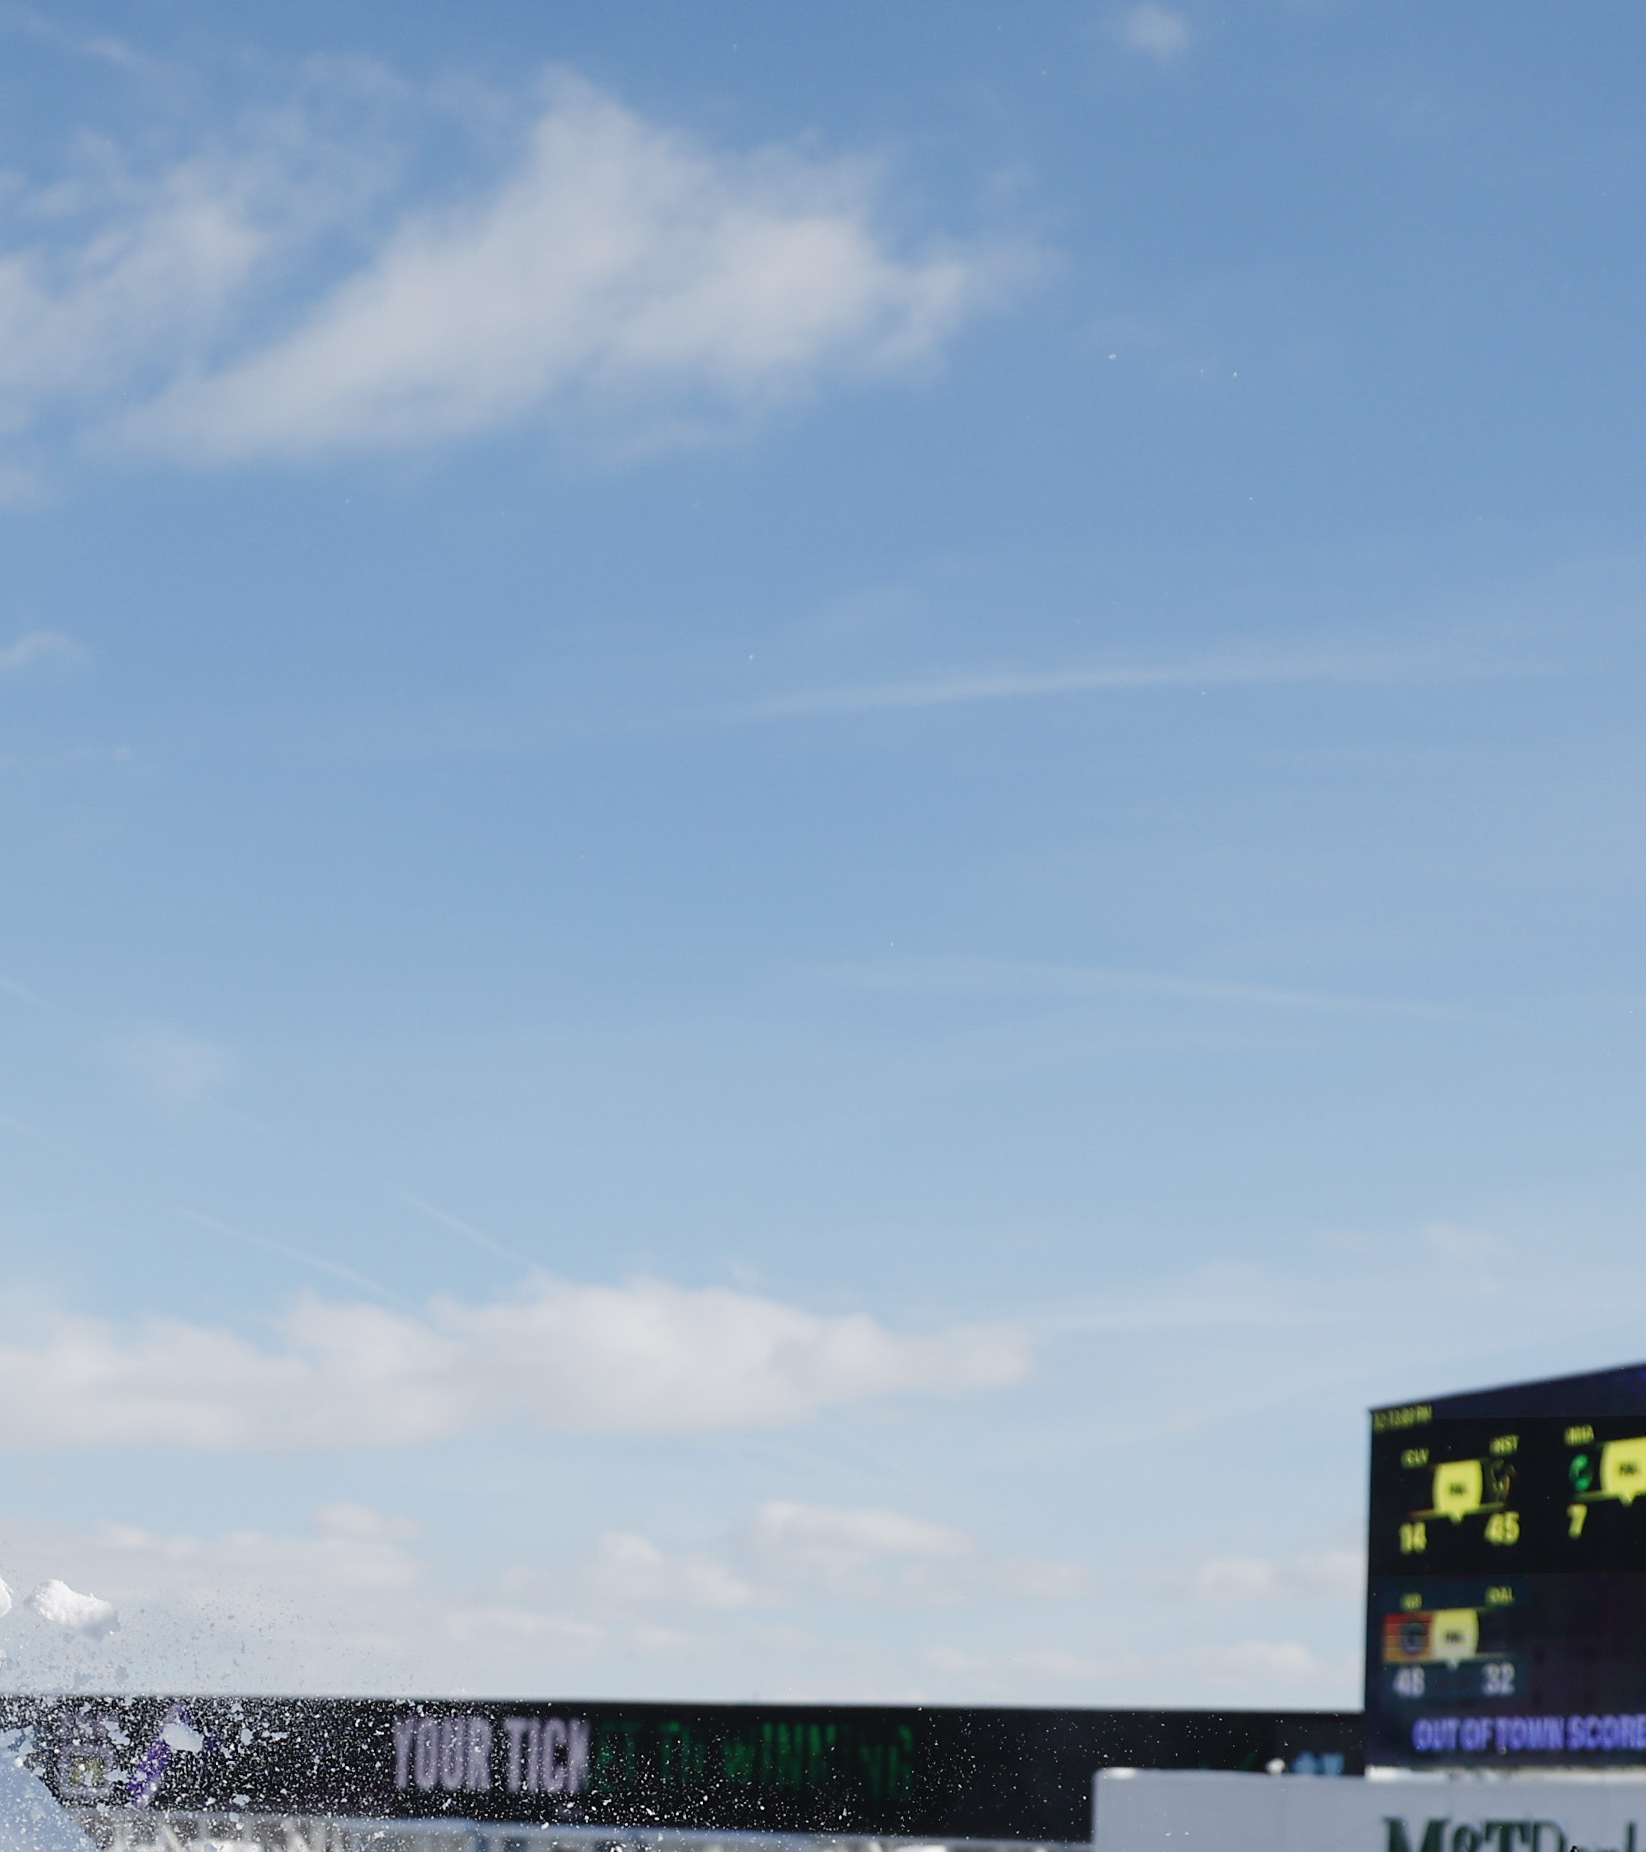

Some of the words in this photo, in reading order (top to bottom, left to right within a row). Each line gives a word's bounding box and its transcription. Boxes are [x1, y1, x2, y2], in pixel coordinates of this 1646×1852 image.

[1484, 1511, 1521, 1546] 45
[1567, 1503, 1587, 1540] 7
[1482, 1662, 1516, 1695] 32
[1412, 1717, 1459, 1752] OUT
[1460, 1717, 1493, 1751] OF
[1494, 1716, 1564, 1751] TOWN
[393, 1718, 492, 1791] YOUR
